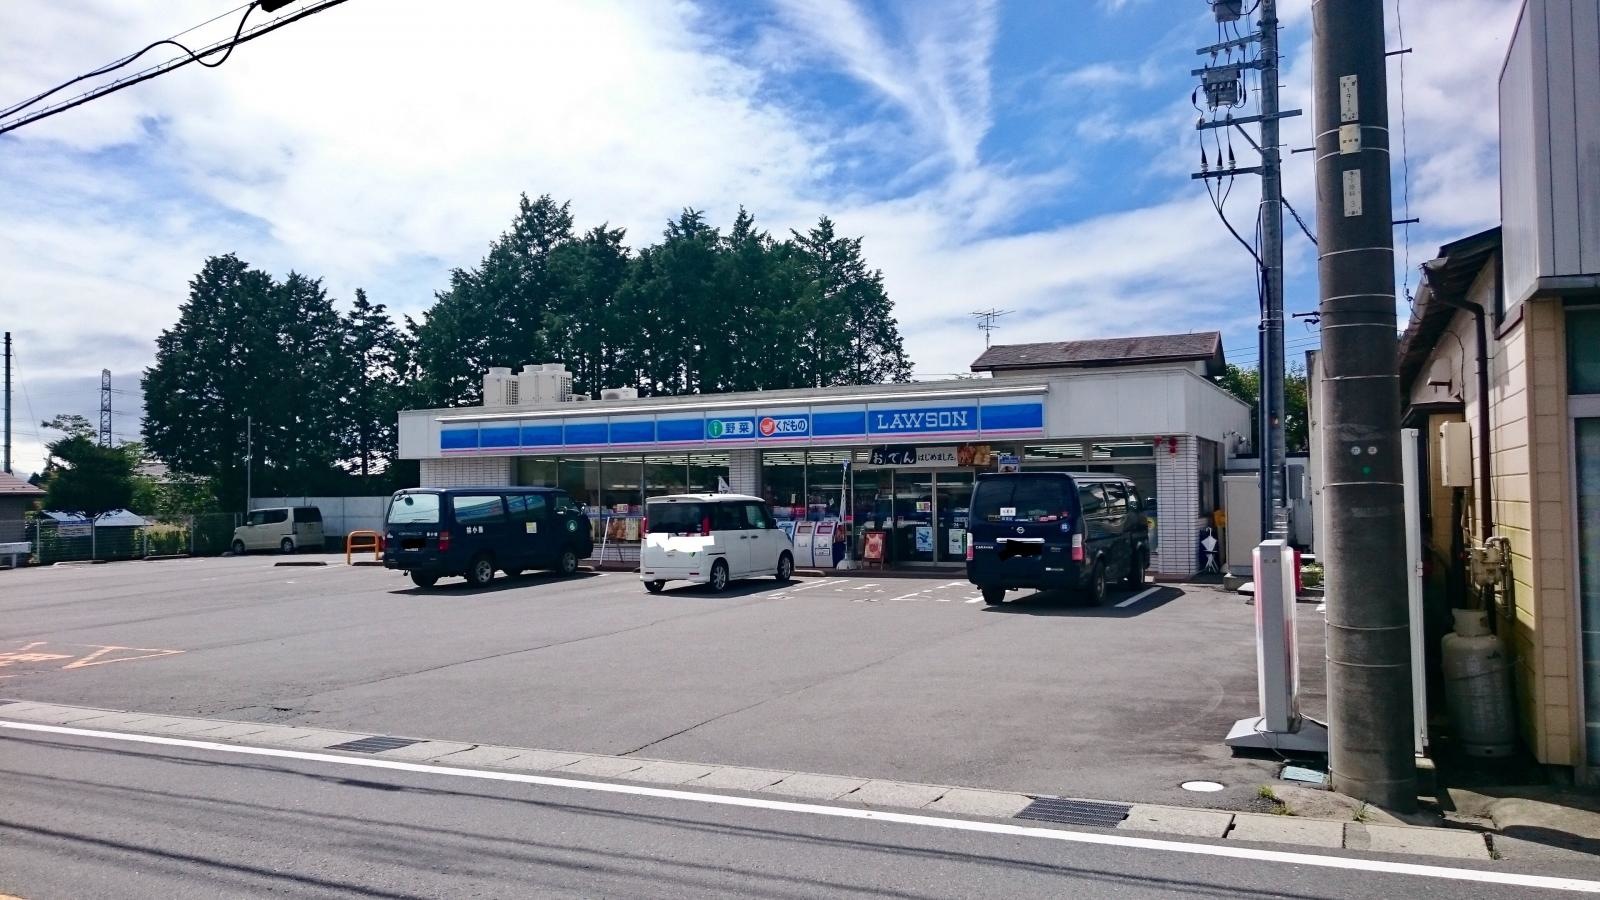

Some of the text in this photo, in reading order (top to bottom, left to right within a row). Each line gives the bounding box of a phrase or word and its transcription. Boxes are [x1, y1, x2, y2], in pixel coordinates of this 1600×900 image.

[775, 420, 806, 431] くだもの
[877, 410, 968, 430] LAWSON
